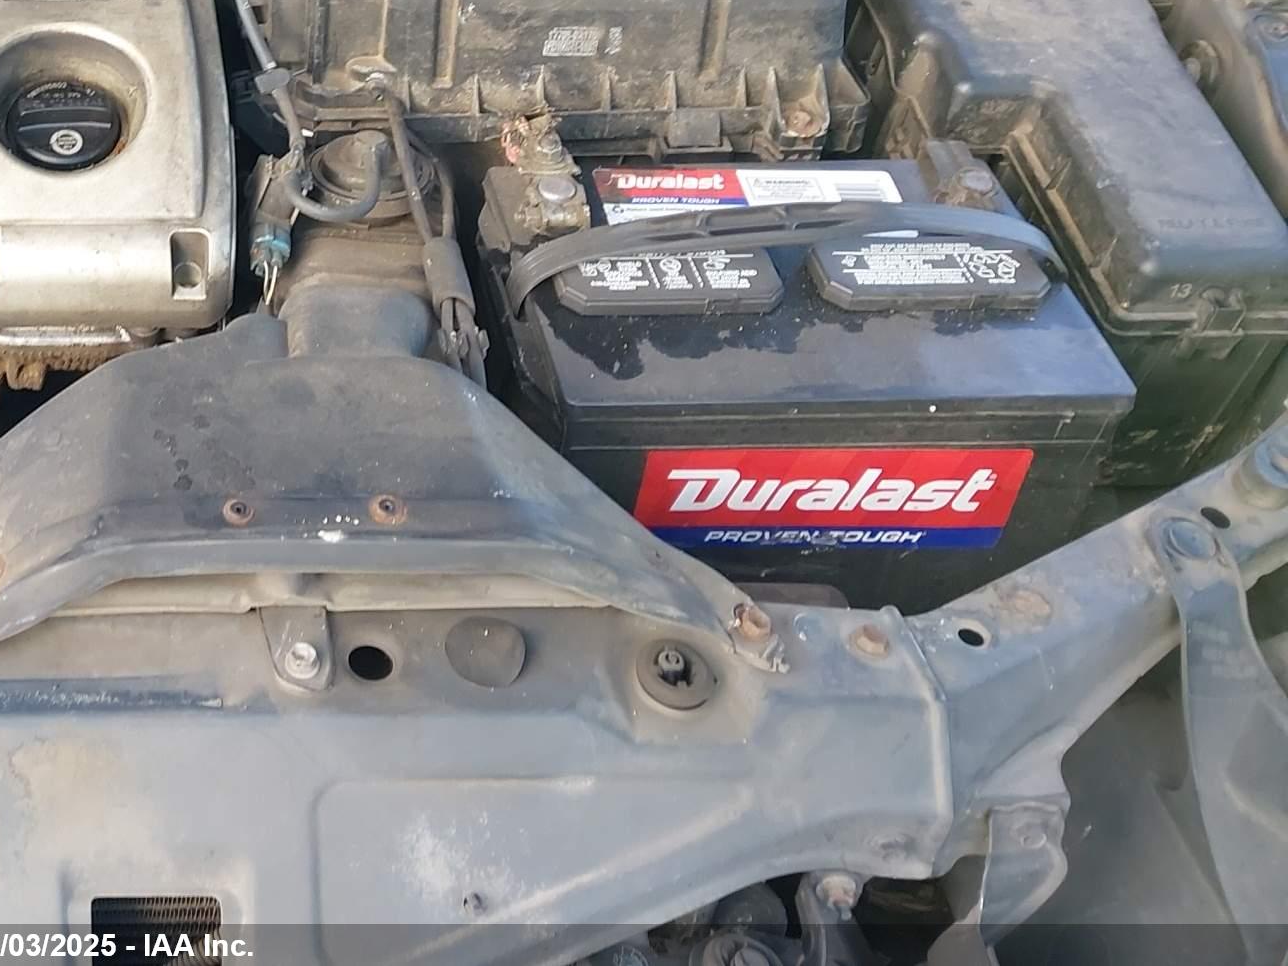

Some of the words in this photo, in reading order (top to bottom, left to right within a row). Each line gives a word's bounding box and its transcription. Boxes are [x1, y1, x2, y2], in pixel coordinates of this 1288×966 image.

[608, 173, 725, 190] Duralast
[1170, 283, 1193, 299] 13
[667, 468, 996, 513] Duralast
[704, 530, 817, 544] PROVEN
